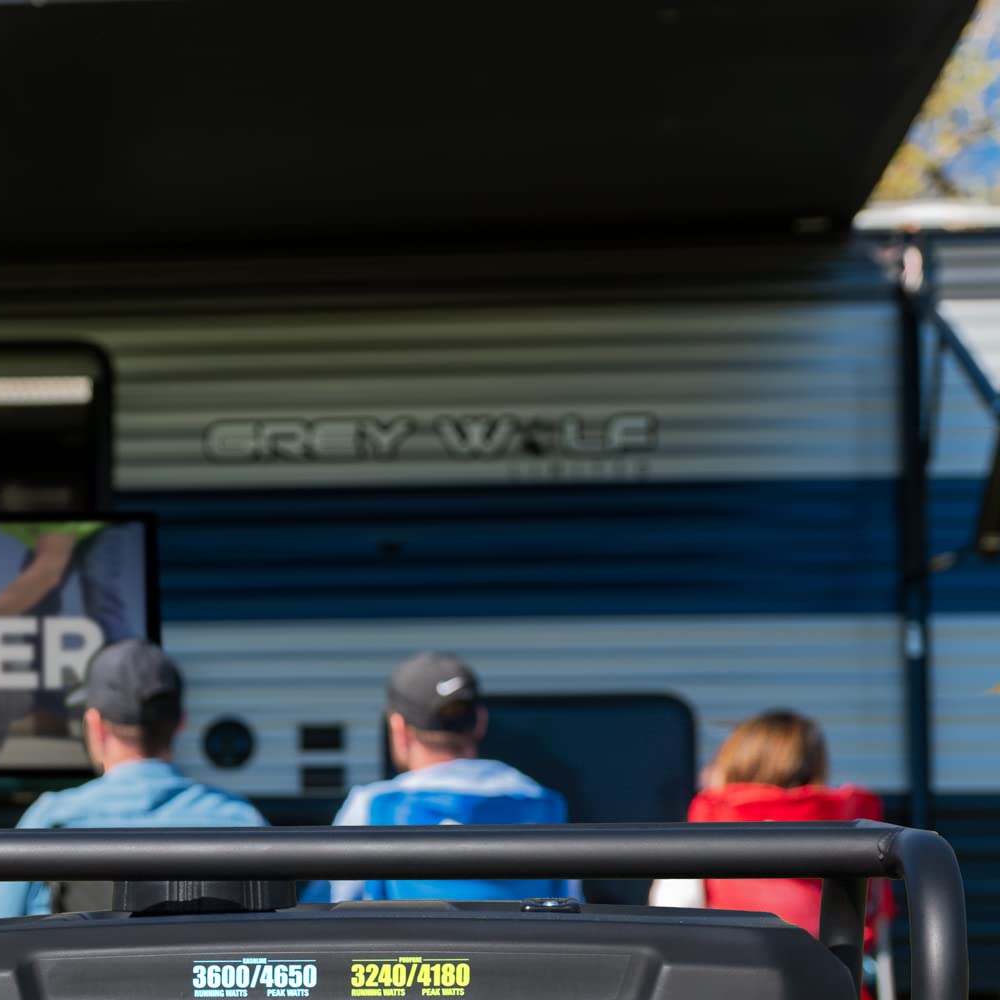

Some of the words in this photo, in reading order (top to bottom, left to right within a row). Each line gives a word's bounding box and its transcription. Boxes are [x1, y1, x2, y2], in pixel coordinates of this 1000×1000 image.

[192, 964, 317, 988] 3600/4650
[351, 963, 470, 987] 3240/4180
[194, 989, 224, 997] RUNNING
[225, 989, 248, 997] WATTS
[267, 989, 286, 997] PEAK
[287, 989, 309, 997] WATTS
[422, 988, 440, 996] PEAK
[442, 988, 464, 996] WATTS
